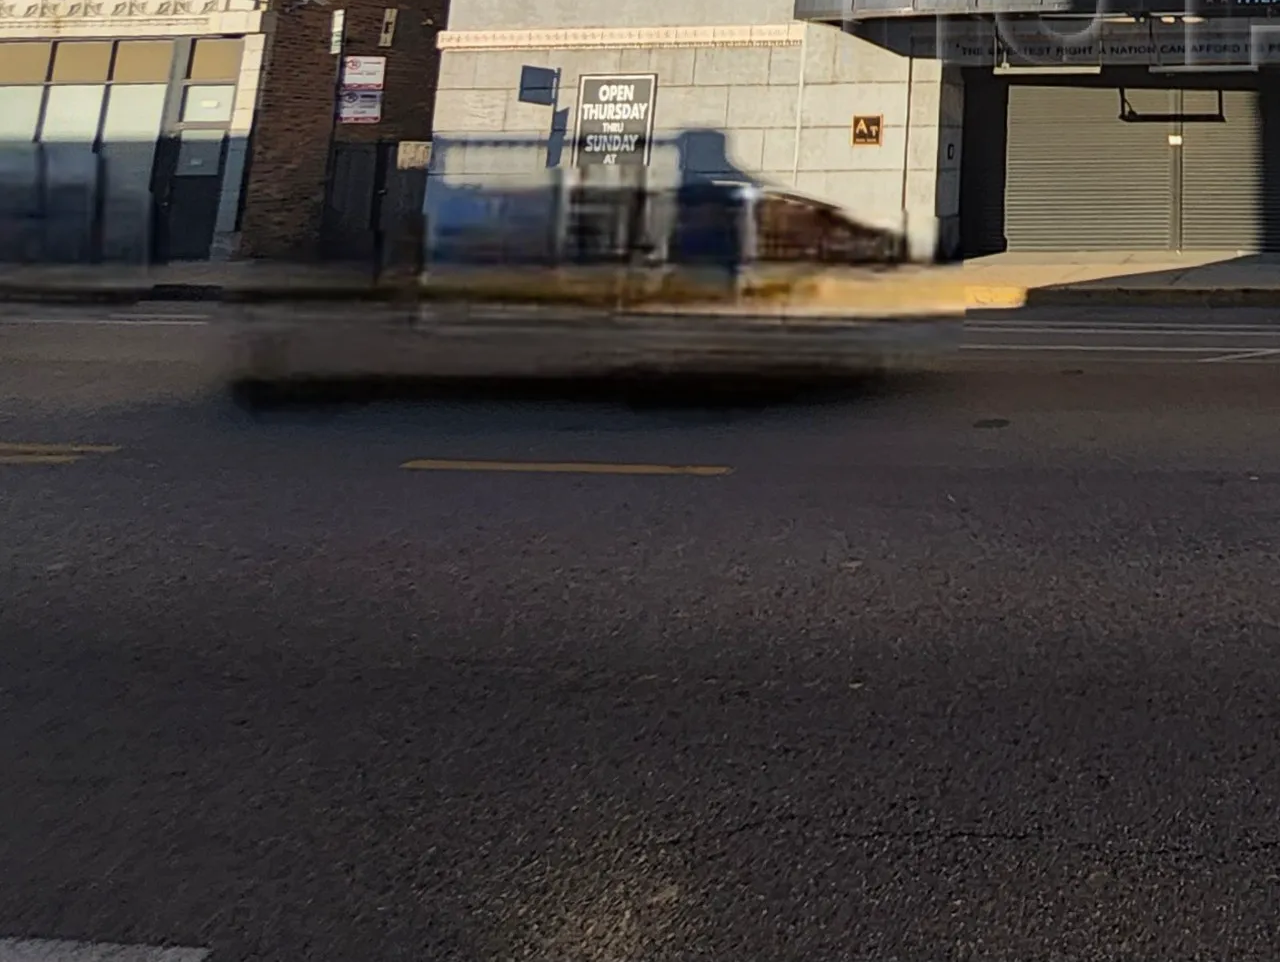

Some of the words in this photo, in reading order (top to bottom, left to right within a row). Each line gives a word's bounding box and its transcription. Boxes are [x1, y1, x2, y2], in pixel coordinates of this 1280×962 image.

[1111, 45, 1155, 54] NATION
[1160, 44, 1185, 54] CAN
[1191, 43, 1240, 53] AFFORD
[598, 85, 634, 101] OPEN
[583, 103, 648, 120] THURSDAY
[602, 122, 624, 133] THRU
[585, 134, 638, 152] SUNDAY
[603, 154, 617, 164] AT
